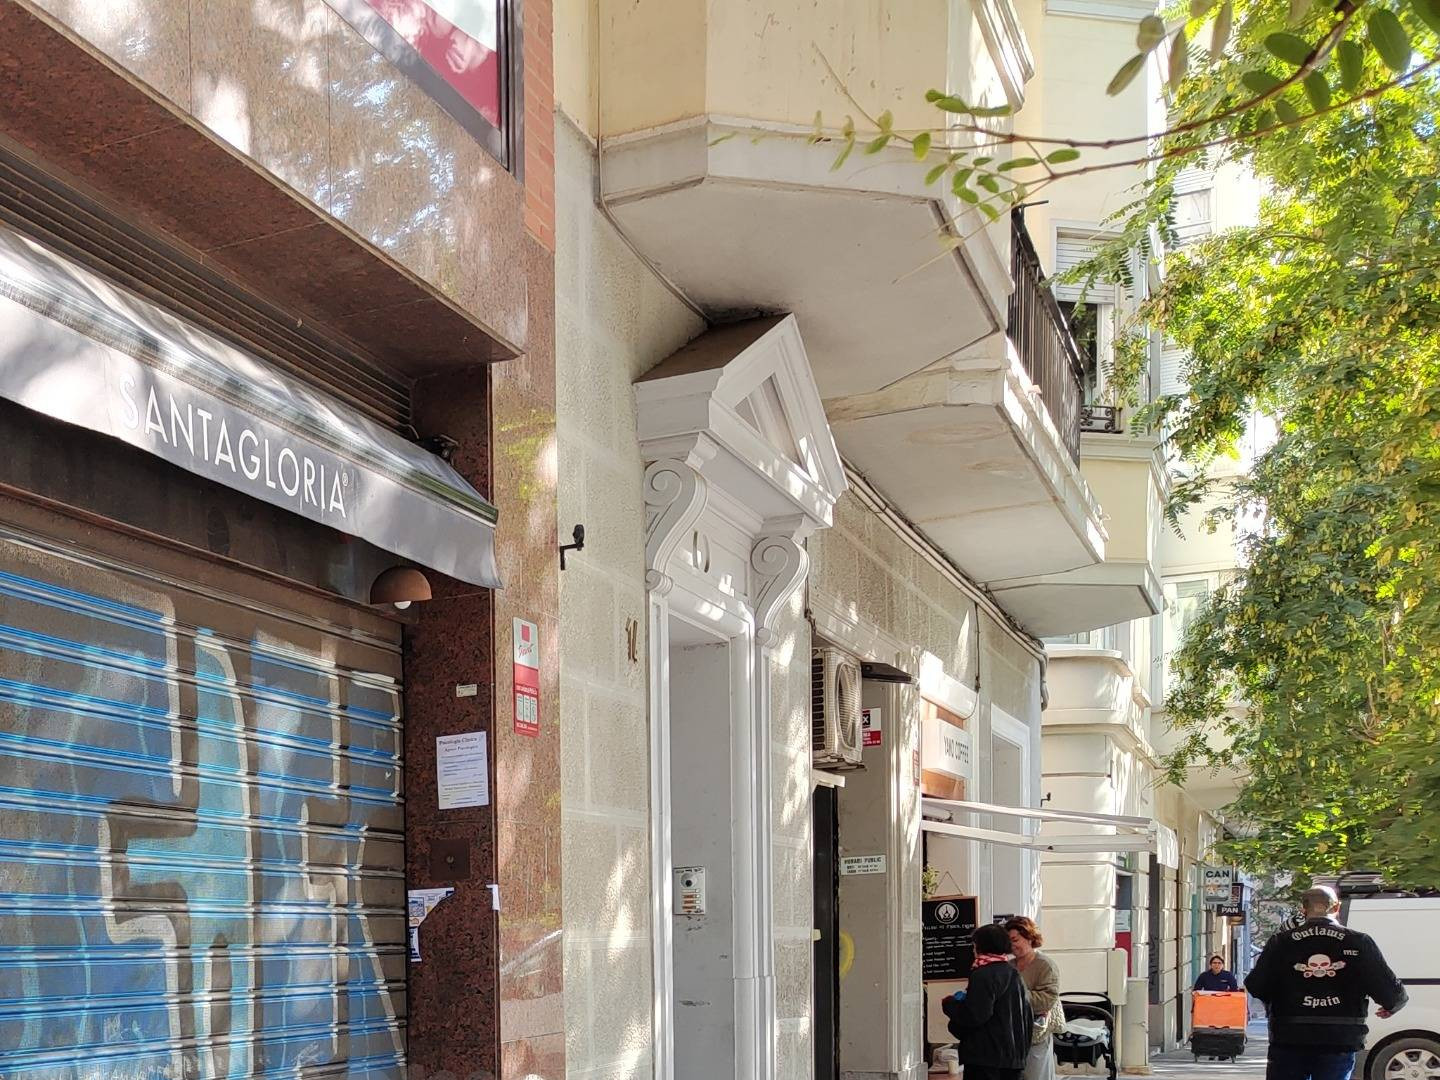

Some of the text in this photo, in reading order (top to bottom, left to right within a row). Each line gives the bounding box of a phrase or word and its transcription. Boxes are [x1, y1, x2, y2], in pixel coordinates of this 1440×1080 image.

[1205, 870, 1230, 878] CAN
[1221, 906, 1239, 914] PAN
[1291, 926, 1346, 941] Outlaws
[1302, 995, 1341, 1008] Spain
